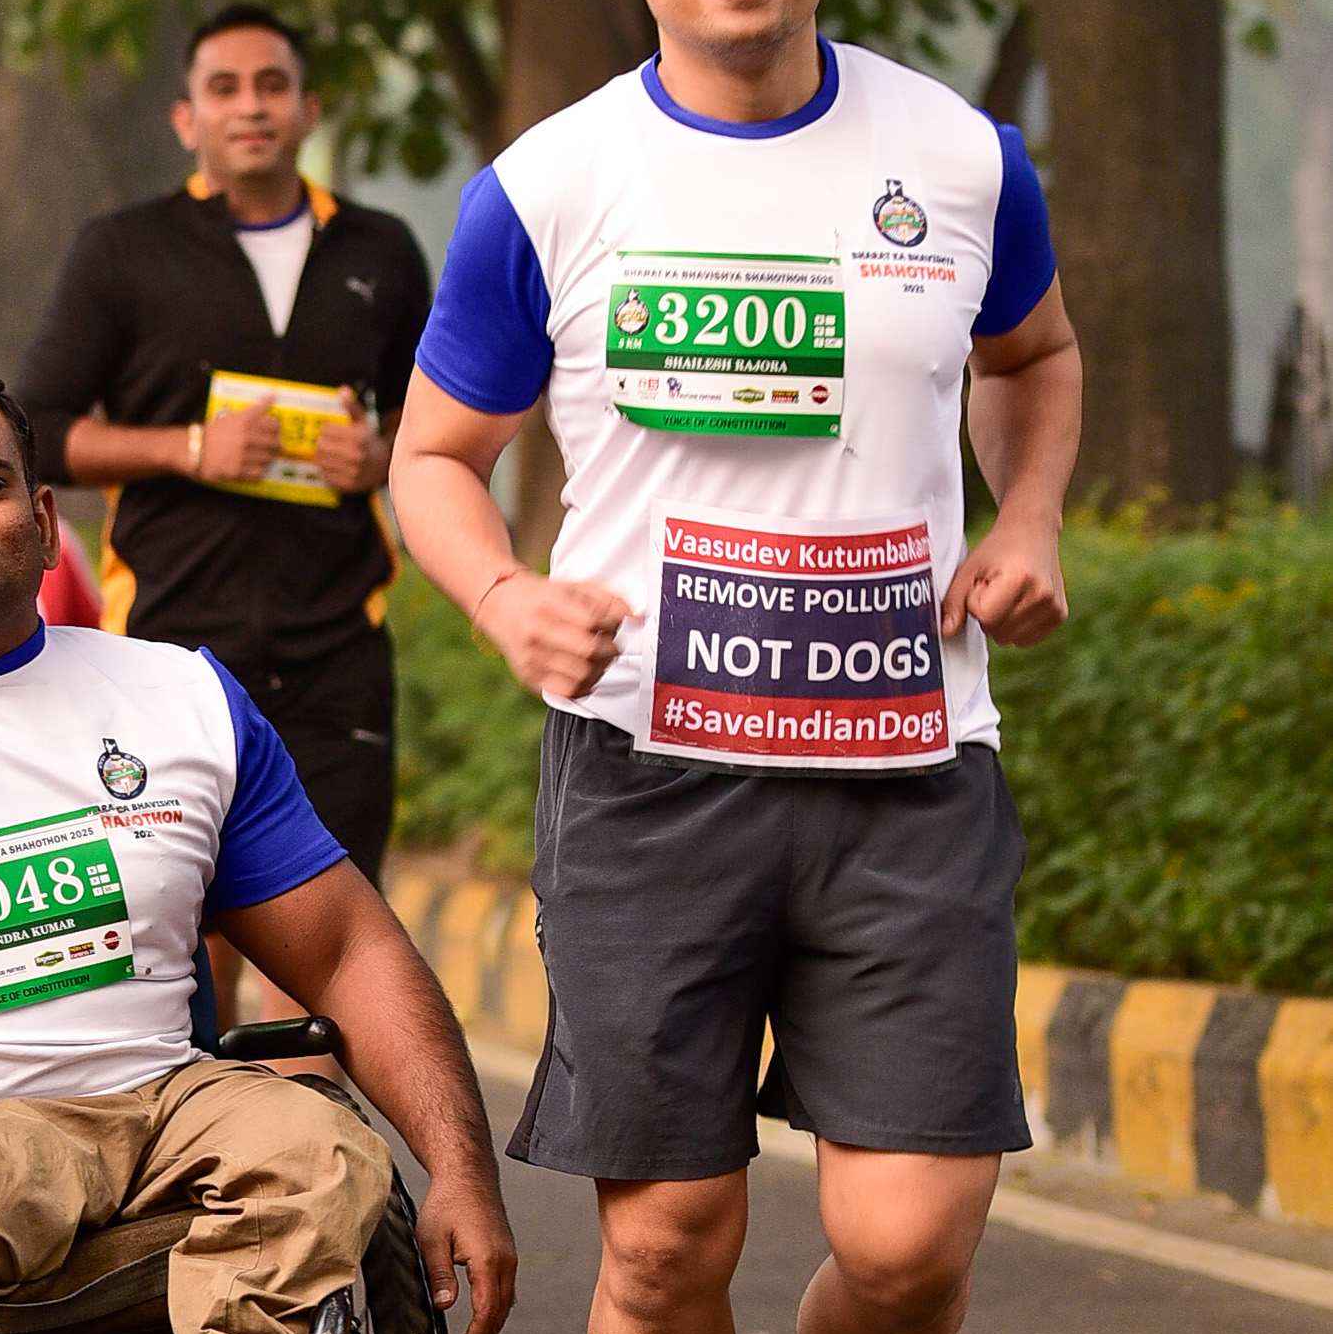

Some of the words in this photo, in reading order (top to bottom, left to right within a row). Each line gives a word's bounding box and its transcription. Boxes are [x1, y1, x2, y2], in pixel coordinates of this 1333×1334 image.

[655, 292, 807, 349] 3200
[665, 526, 790, 566] Vaasudev
[677, 573, 795, 612] REMOVE
[804, 579, 931, 614] POLLUTION
[686, 629, 792, 681] NOT
[808, 633, 931, 683] DOGS
[664, 697, 943, 743] #SaveIndianDogs
[9, 833, 68, 855] SHAHOTHON
[70, 827, 95, 841] 2025
[33, 918, 77, 938] KUMAR
[8, 989, 22, 1001] OF
[23, 973, 91, 999] CONSTITUTION
